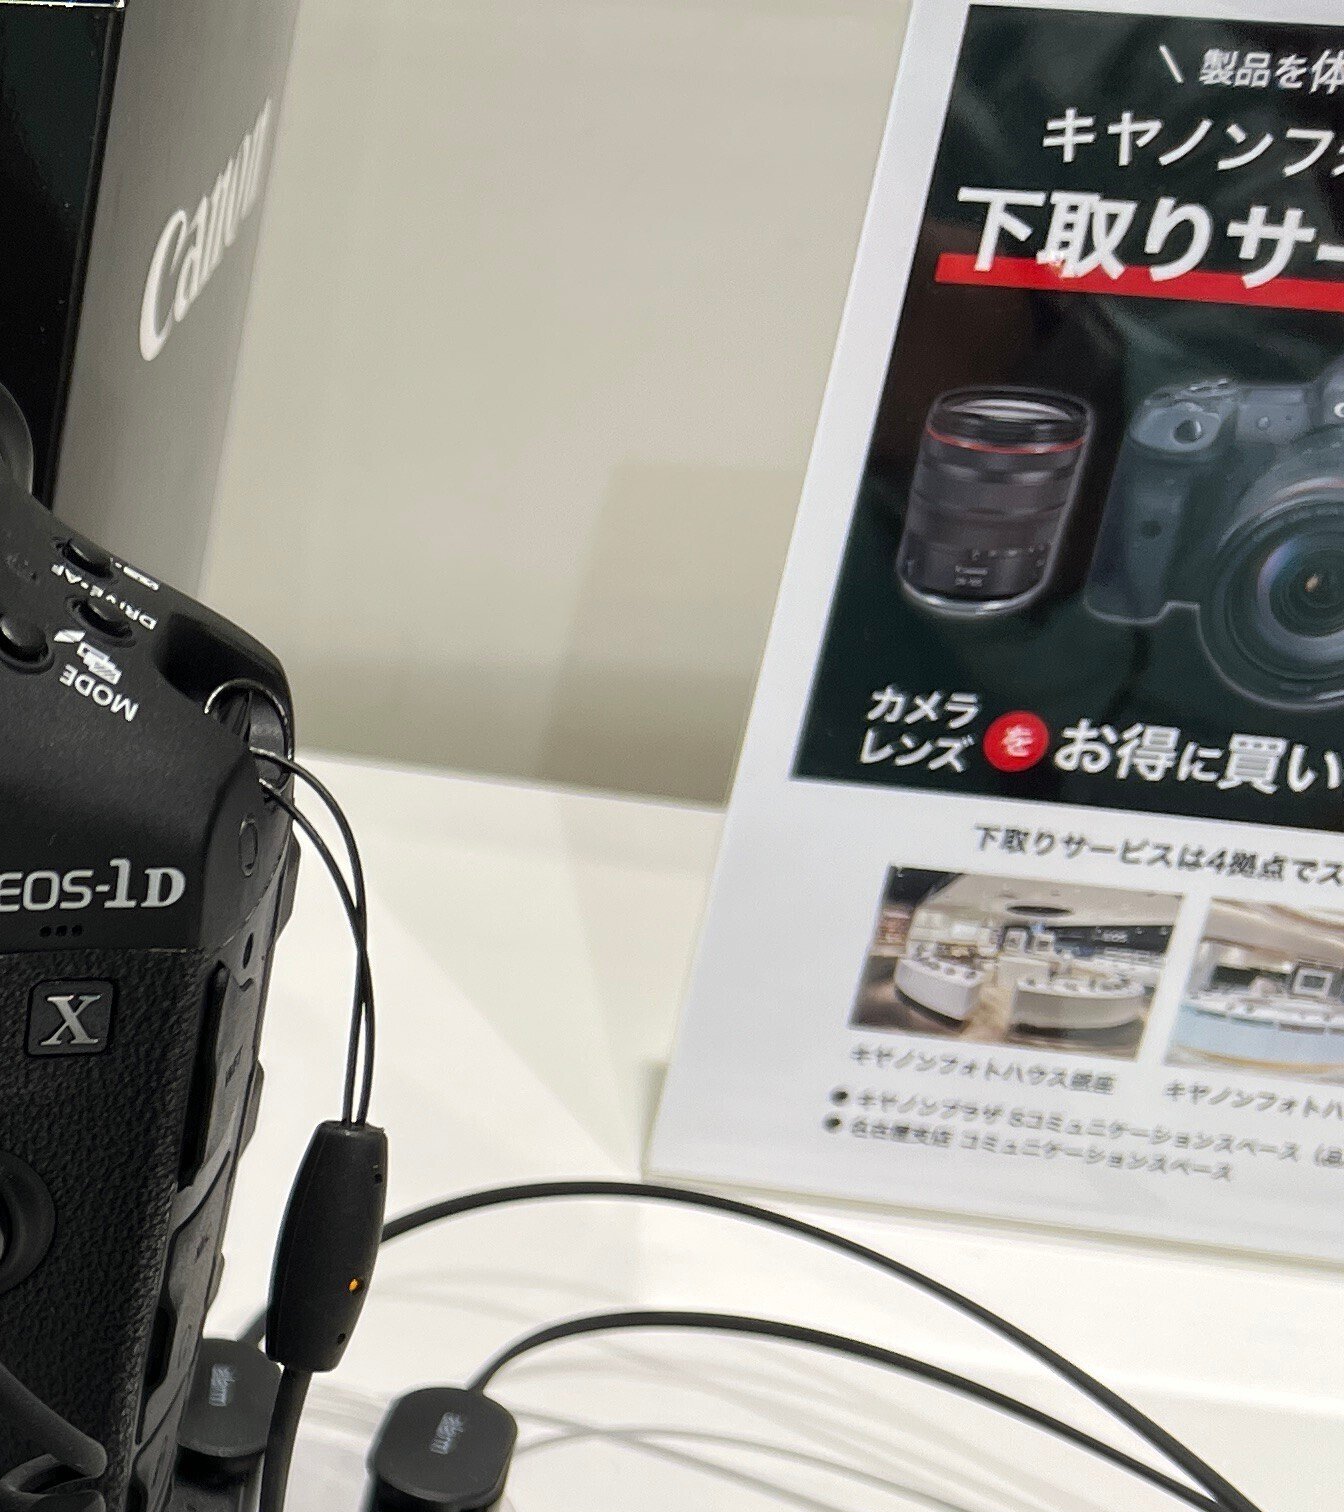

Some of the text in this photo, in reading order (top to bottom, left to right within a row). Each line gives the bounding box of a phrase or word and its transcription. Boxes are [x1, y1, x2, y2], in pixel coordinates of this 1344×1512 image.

[139, 97, 274, 362] Canon
[59, 663, 140, 723] MODE
[866, 684, 981, 727] カメラ
[859, 729, 975, 774] レンズ
[40, 994, 102, 1046] X
